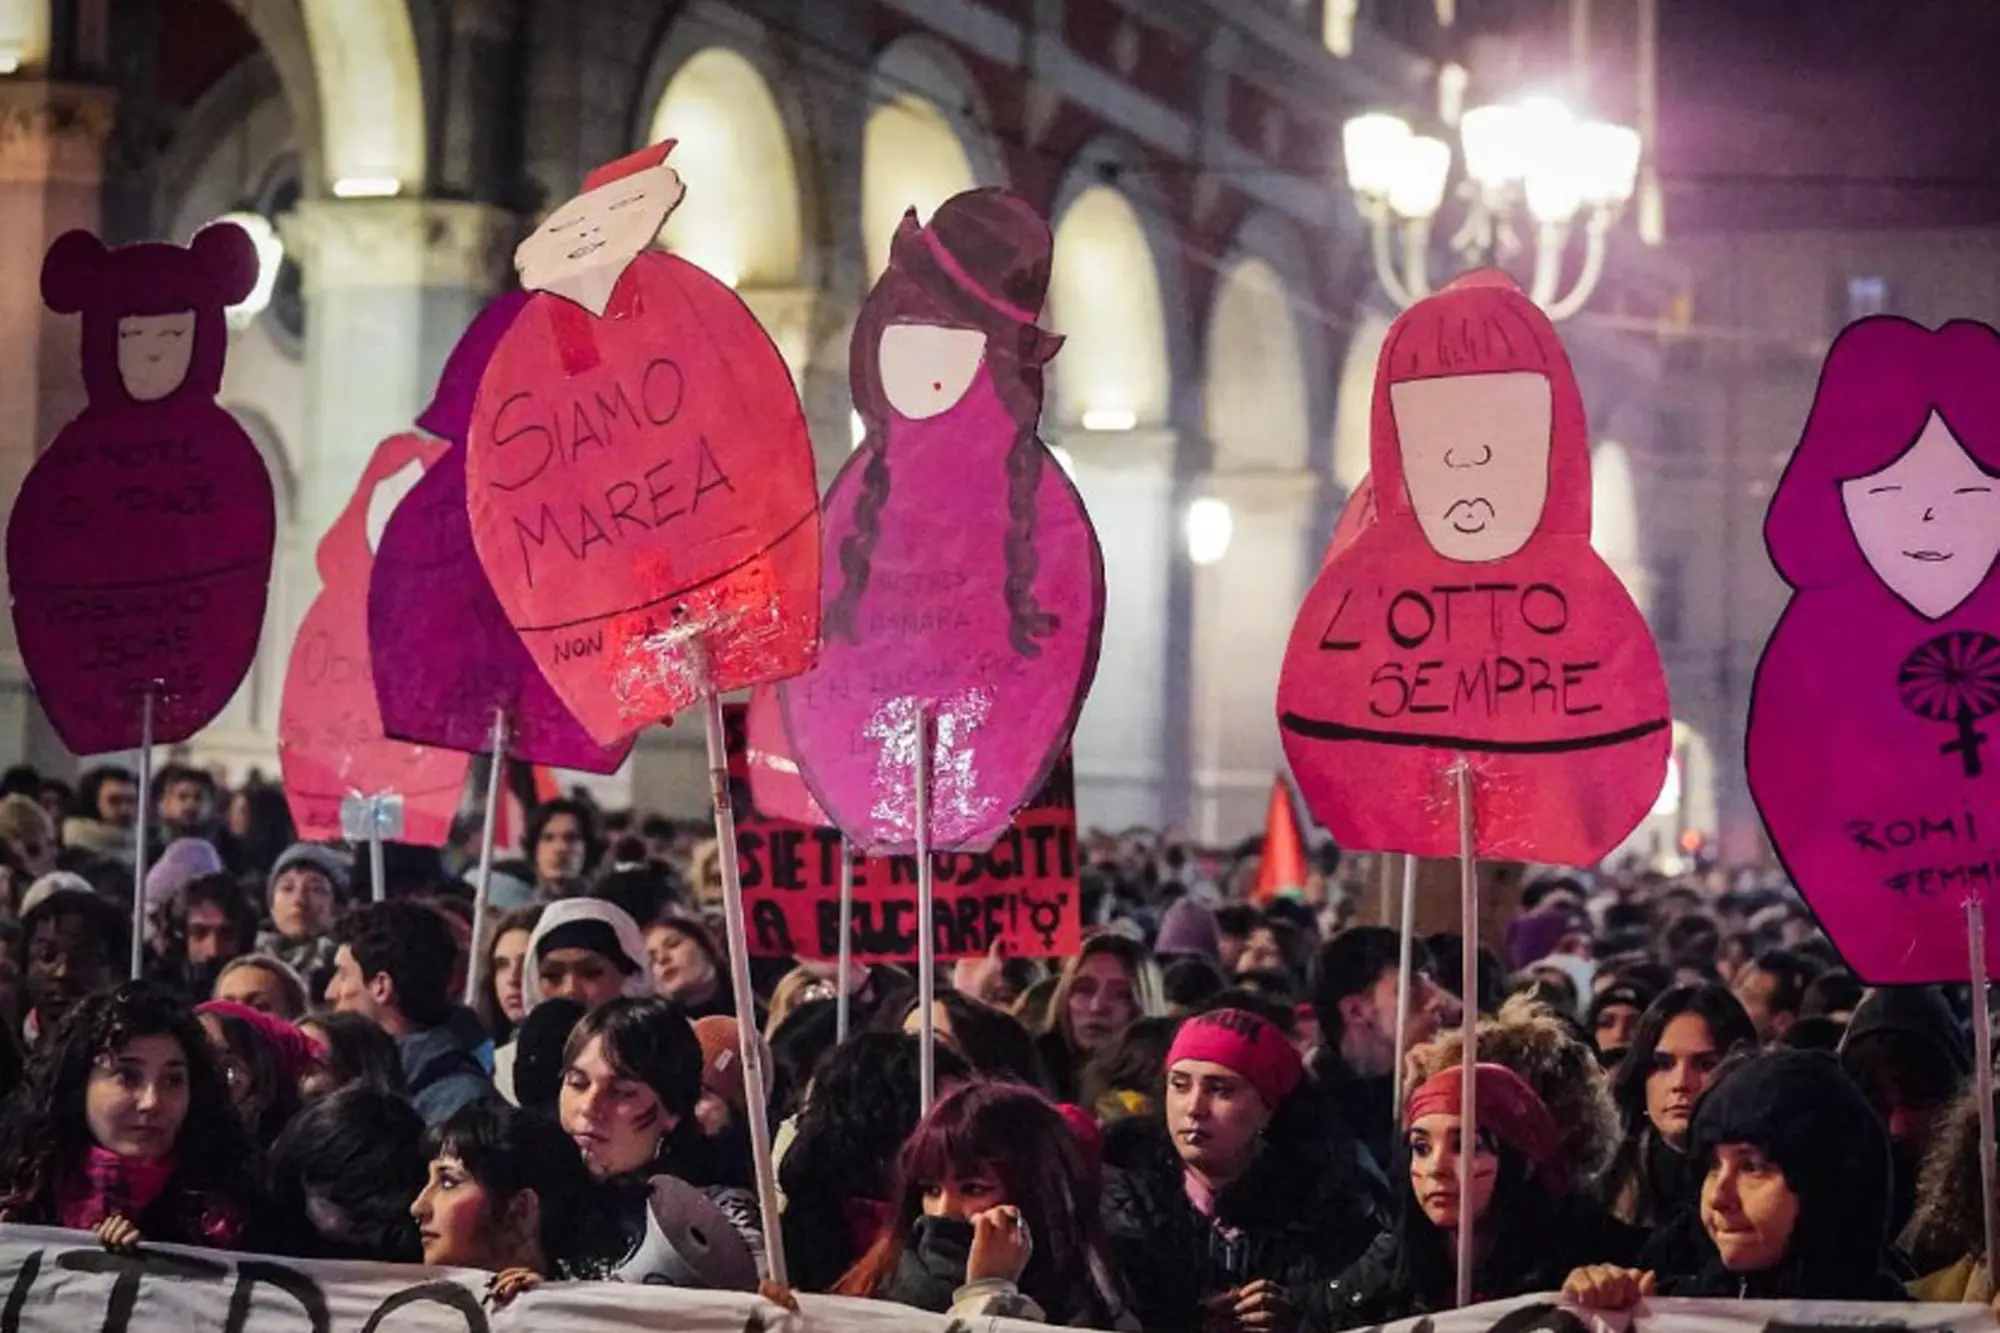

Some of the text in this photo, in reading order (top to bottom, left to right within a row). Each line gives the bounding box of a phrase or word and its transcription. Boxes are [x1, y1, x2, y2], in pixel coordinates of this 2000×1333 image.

[490, 358, 684, 491] SIAMO
[513, 436, 736, 589] MAREA
[553, 631, 603, 664] NON
[1319, 583, 1568, 650] L'OTTO
[1369, 657, 1603, 718] SEMPRE
[752, 899, 797, 954] A
